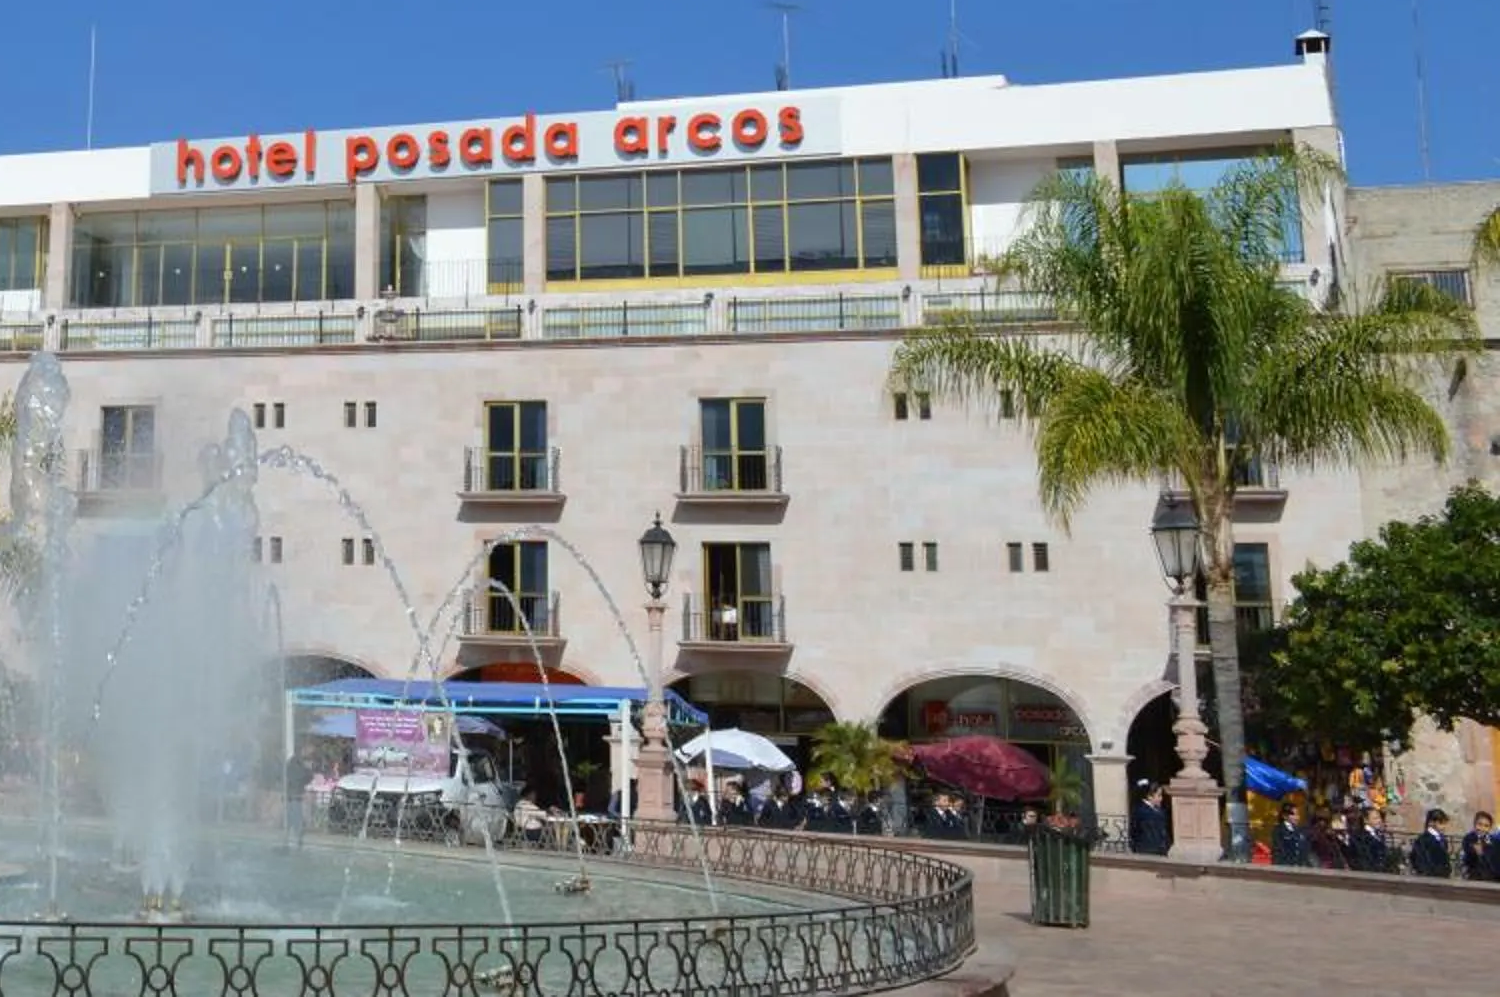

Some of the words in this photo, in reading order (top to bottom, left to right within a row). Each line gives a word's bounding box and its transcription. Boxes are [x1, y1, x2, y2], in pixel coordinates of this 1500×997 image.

[175, 130, 318, 183] hotel
[345, 114, 579, 182] posada
[613, 105, 805, 155] arcos
